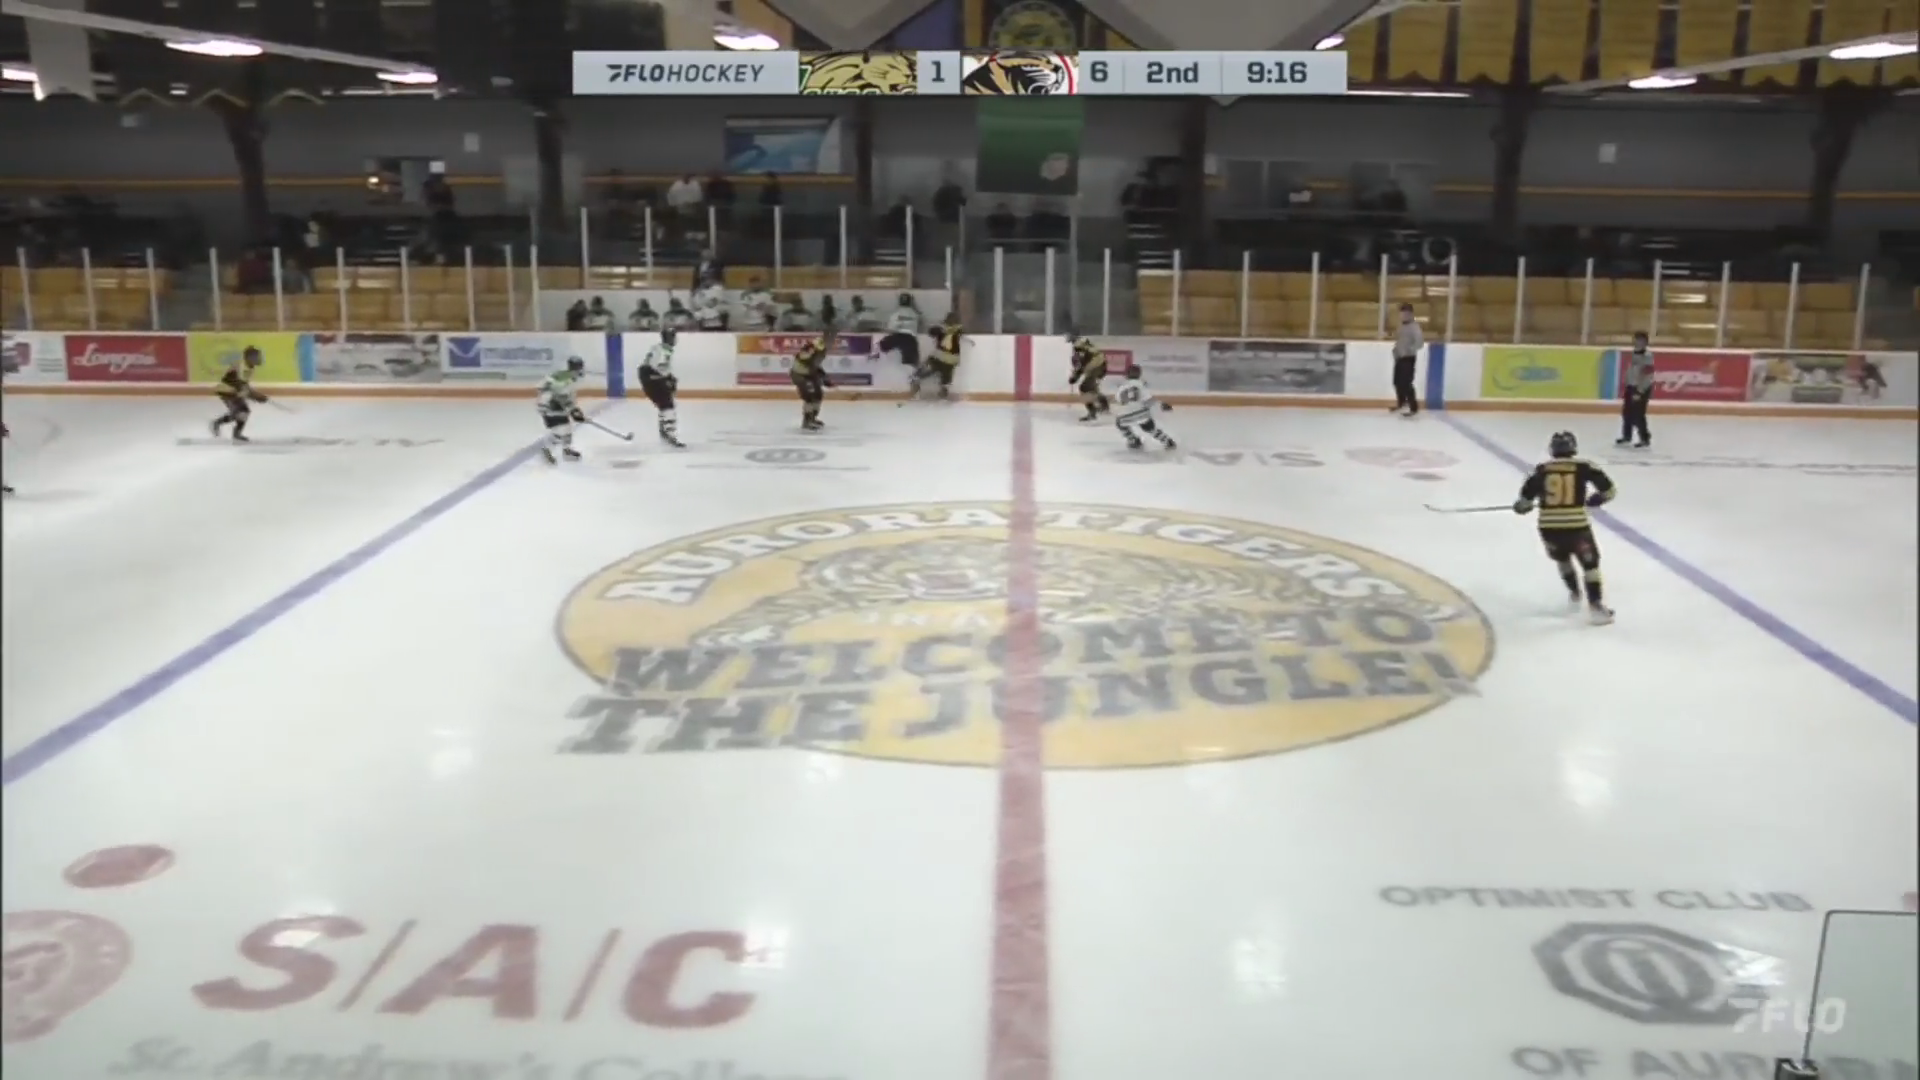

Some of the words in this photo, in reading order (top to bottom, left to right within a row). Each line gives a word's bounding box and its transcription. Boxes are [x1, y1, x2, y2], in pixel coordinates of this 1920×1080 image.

[1543, 472, 1576, 505] 91
[603, 507, 1012, 603] AURORA
[1040, 510, 1406, 598] TIGERS
[610, 606, 1254, 694] WELCOME
[1266, 606, 1434, 650] TO
[556, 689, 870, 754] THE
[1379, 885, 1637, 909] OPTIMIST
[1656, 888, 1816, 911] CLUB
[1510, 1046, 1602, 1079] OF
